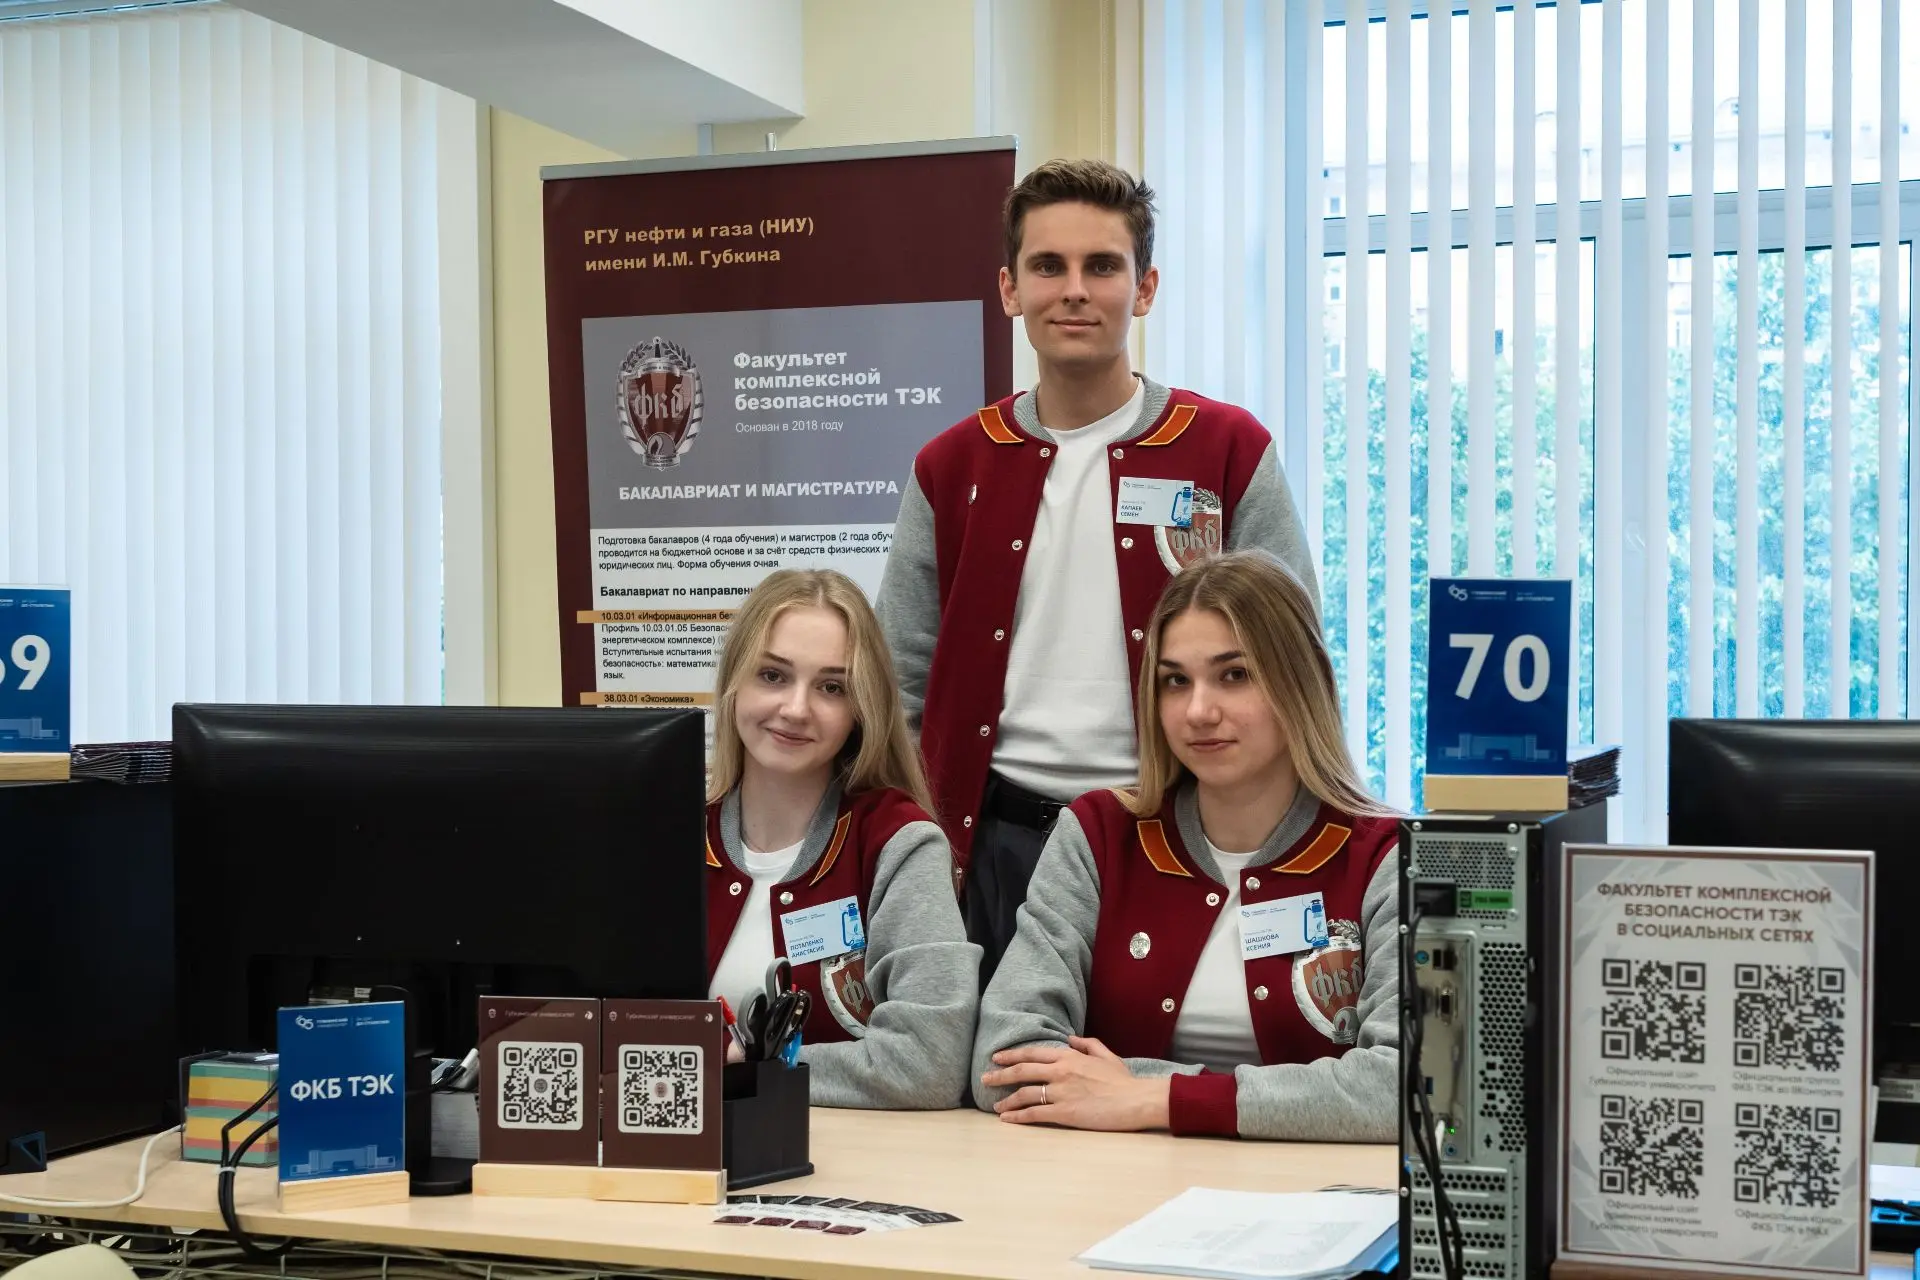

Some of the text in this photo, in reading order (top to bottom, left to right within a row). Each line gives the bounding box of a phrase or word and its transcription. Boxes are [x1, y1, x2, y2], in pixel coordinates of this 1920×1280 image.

[584, 216, 814, 245] РГУ нефти и газа (НИУ)
[585, 248, 781, 272] имени И.М. Губкина
[733, 351, 848, 371] Факультет
[734, 367, 881, 390] комплексной
[734, 386, 942, 411] безопасности ТЭК
[735, 420, 844, 433] Основан в 2018 году
[619, 480, 899, 501] БАКАЛАВРИАТ И МАГИСТРАТУРА
[598, 535, 647, 546] Подготовка
[648, 534, 699, 546] бакалавров
[701, 534, 710, 545] (4
[713, 535, 733, 545] года
[734, 532, 779, 546] обучения)
[781, 534, 787, 542] и
[789, 533, 837, 544] магистров
[838, 532, 848, 542] (2
[850, 532, 870, 542] года
[598, 549, 648, 559] проводится
[649, 549, 660, 557] на
[661, 547, 712, 558] бюджетной
[713, 547, 745, 556] основе
[747, 548, 753, 556] и
[755, 547, 765, 555] за
[766, 546, 786, 555] счёт
[788, 546, 826, 557] средств
[827, 544, 881, 557] физических
[599, 561, 655, 571] юридических
[656, 561, 675, 571] лиц.
[677, 559, 708, 571] Форма
[709, 558, 752, 571] обучения
[600, 585, 670, 598] Бакалавриат
[672, 587, 687, 597] по
[601, 612, 636, 621] 10.03.01
[637, 611, 718, 622] «Информационная
[601, 623, 640, 634] Профиль
[642, 623, 688, 633] 10.03.01.05
[601, 636, 666, 646] энергетическом
[667, 635, 716, 646] комплексе)
[602, 647, 664, 658] Вступительные
[666, 647, 712, 657] испытания
[602, 659, 665, 668] безопасность»:
[1448, 632, 1552, 703] 70
[604, 693, 695, 704] 38.03.01 «Экономика»
[1597, 883, 1833, 905] ФАКУЛЬТЕТ КОМПЛЕКСНОЙ
[1624, 902, 1804, 923] БЕЗОПАСНОСТИ ТЭК
[1244, 933, 1280, 944] ШАШКОВА
[1616, 922, 1815, 944] В СОЦИАЛЬНЫХ СЕТЯХ
[791, 945, 825, 958] АНАСТАСИЯ
[1246, 942, 1271, 952] КСЕНИЯ
[289, 1073, 395, 1102] ФКБ ТЭК
